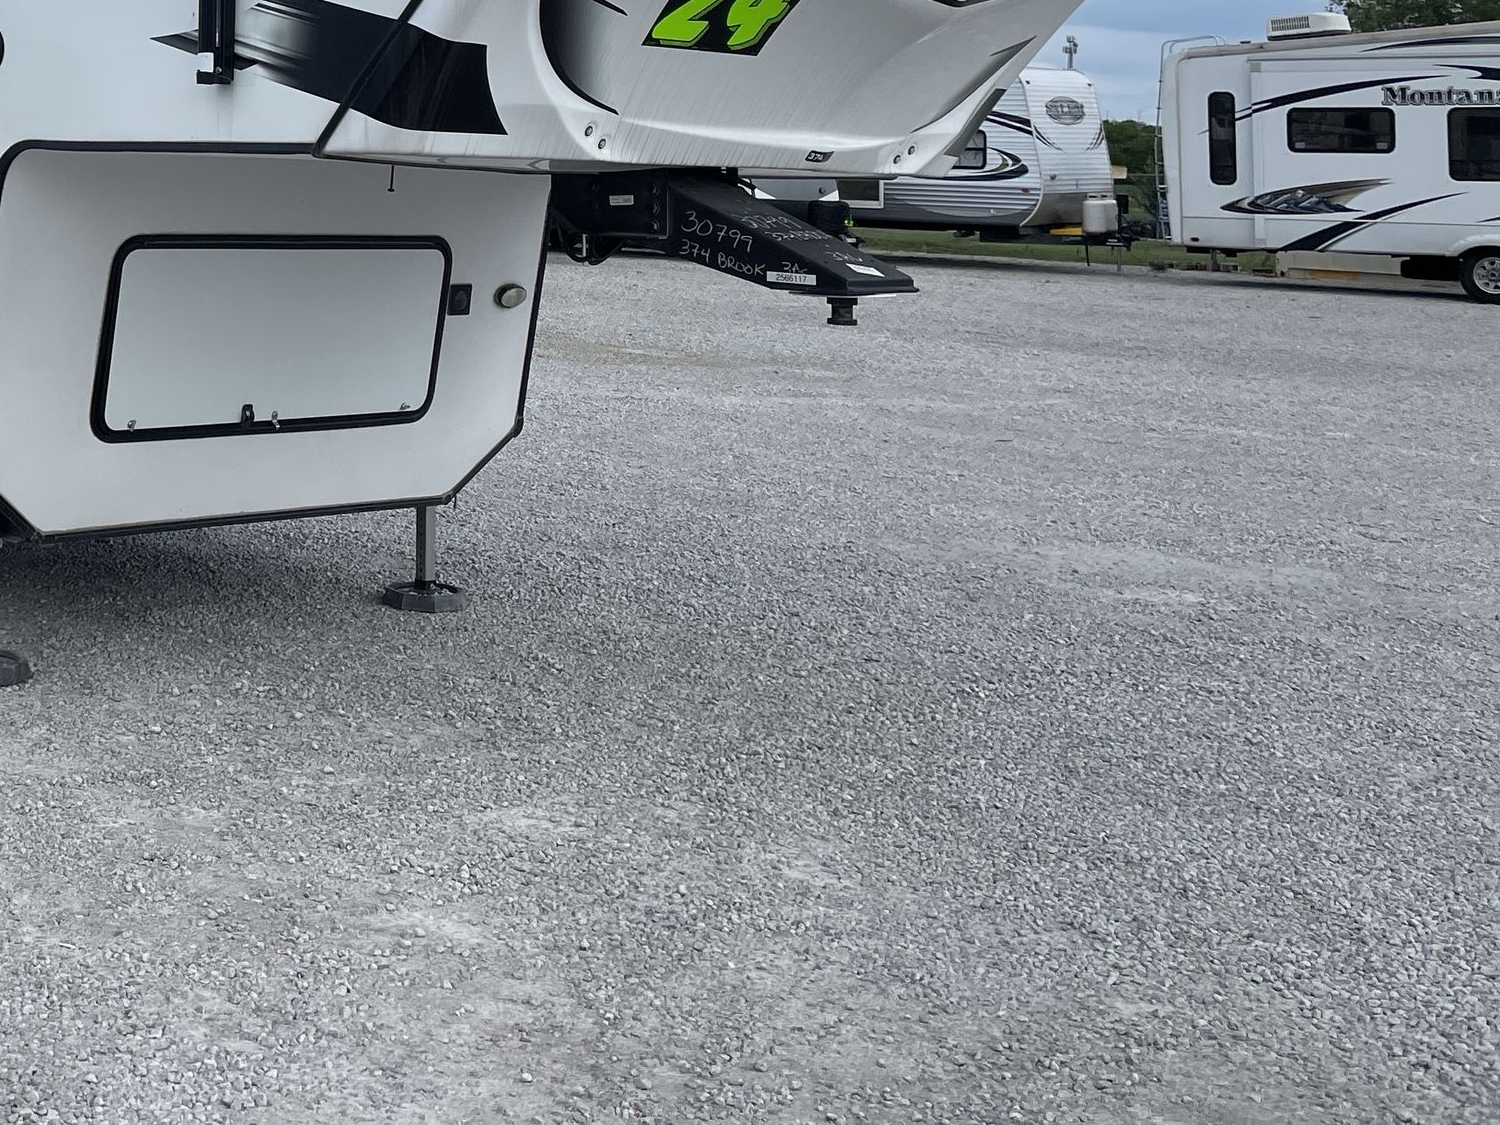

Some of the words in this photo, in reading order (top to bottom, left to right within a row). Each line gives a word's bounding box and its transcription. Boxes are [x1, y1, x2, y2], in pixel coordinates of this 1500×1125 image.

[1381, 85, 1500, 106] Montan
[681, 211, 753, 253] 30799
[679, 239, 711, 264] 374
[717, 252, 766, 275] BROOK
